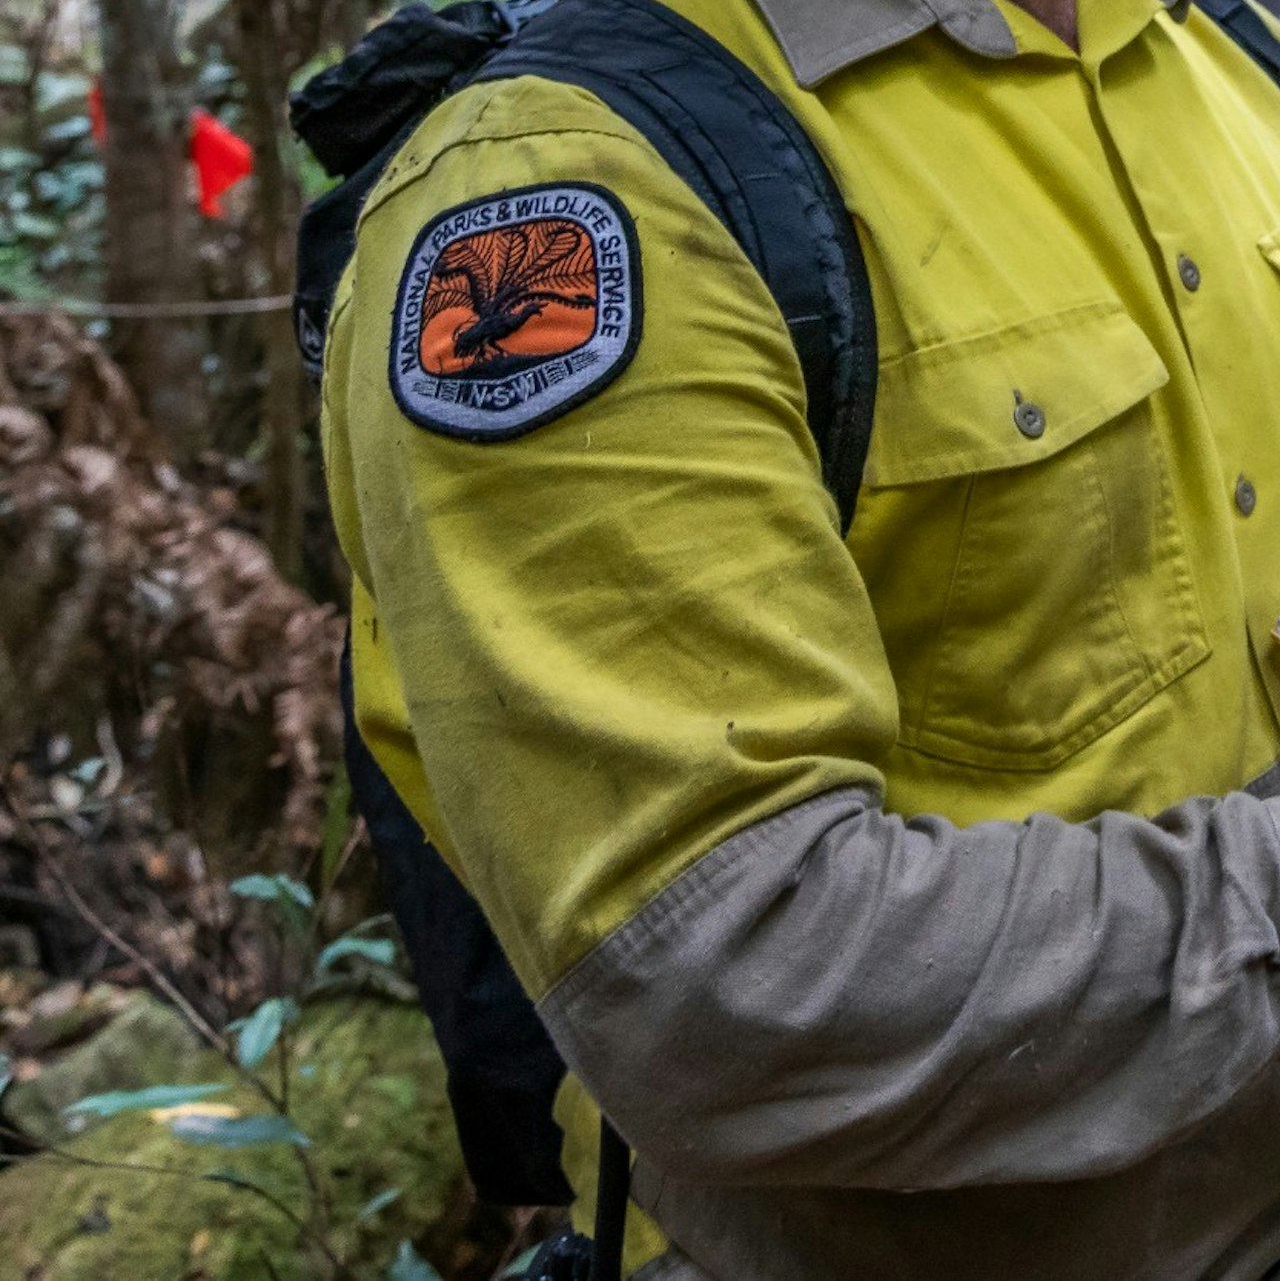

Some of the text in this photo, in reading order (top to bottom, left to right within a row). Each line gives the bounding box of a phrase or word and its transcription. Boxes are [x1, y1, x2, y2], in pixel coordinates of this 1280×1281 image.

[401, 197, 625, 374] NATIONAL PARKS & WILDLIFE SERVICE
